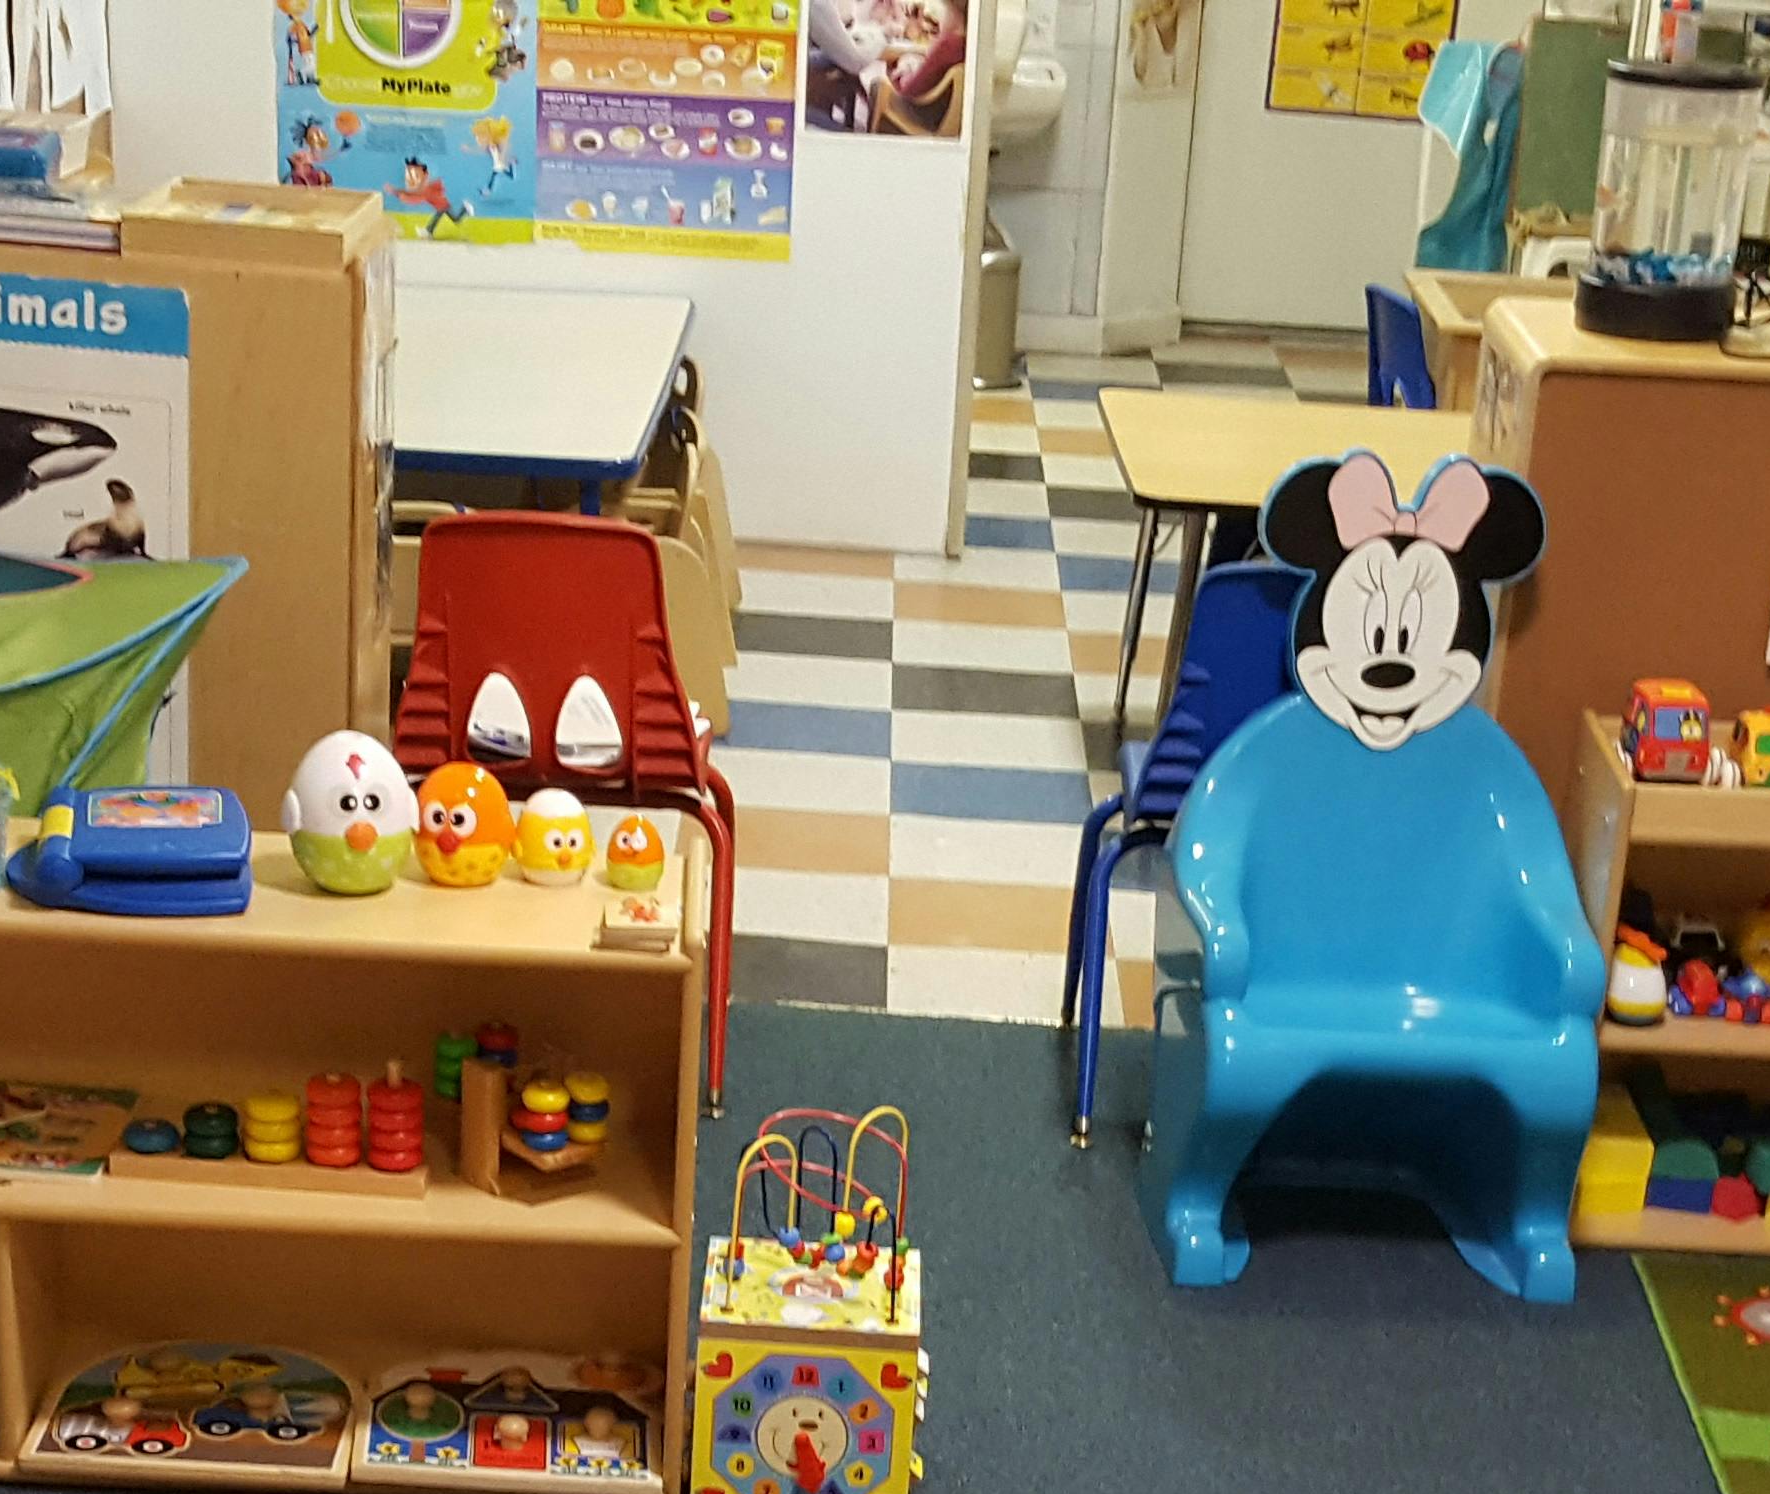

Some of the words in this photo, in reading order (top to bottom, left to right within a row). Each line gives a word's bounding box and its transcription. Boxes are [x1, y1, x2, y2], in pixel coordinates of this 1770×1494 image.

[381, 77, 452, 95] MyPlate
[798, 1367, 814, 1382] 12
[733, 1398, 751, 1413] 10
